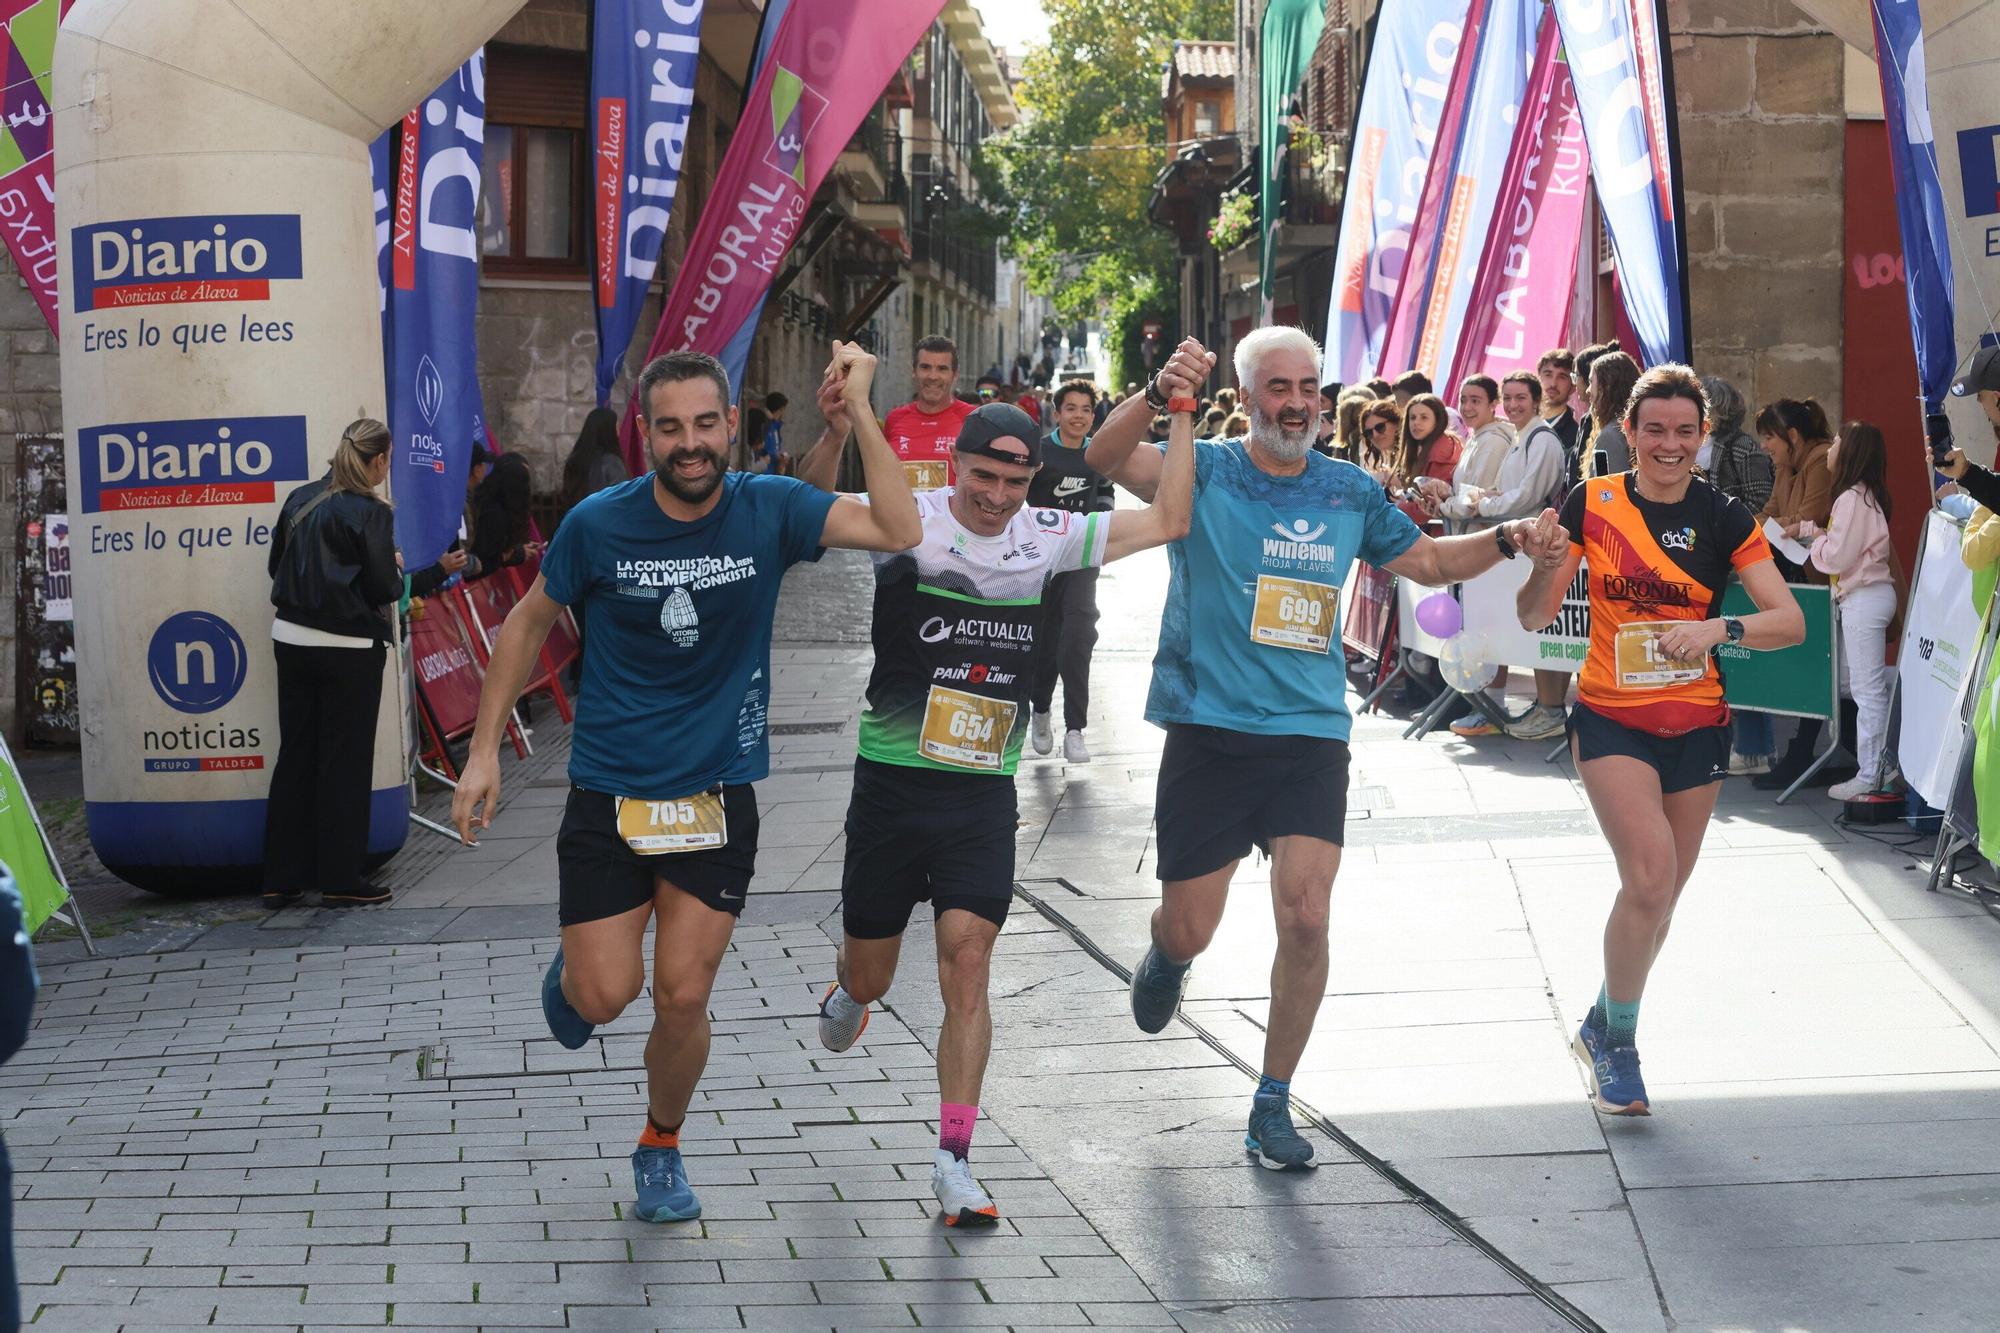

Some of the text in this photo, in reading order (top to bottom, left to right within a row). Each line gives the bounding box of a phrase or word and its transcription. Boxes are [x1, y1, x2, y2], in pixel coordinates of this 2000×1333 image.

[597, 104, 621, 170] Álava
[393, 132, 416, 257] Noticias
[752, 193, 805, 274] kutxa
[92, 223, 268, 281] Diario
[113, 280, 239, 305] Noticias de Álava
[84, 314, 294, 353] Eres lo que lees
[98, 426, 273, 483] Diario
[916, 469, 930, 484] 14
[1060, 476, 1087, 489] NIKE
[119, 484, 244, 508] Noticias de Álava
[1058, 498, 1084, 508] AIR
[91, 525, 134, 554] Eres
[144, 521, 166, 550] lo
[178, 527, 232, 557] que
[616, 560, 633, 572] LA
[616, 571, 628, 579] DE
[629, 571, 640, 579] LA
[1262, 556, 1335, 573] RIOJA ALAVESA
[692, 565, 757, 591] KONKISTA
[1603, 574, 1690, 600] FORONDA
[1278, 595, 1322, 626] 699
[672, 628, 699, 637] VITORIA
[672, 635, 700, 643] GASTEIZ
[955, 619, 1034, 642] ACTUALIZA
[954, 637, 985, 647] software
[990, 640, 1019, 650] websites
[1540, 641, 1591, 661] green capit
[1718, 644, 1751, 660] Gasteizko
[175, 640, 216, 685] n
[933, 667, 970, 681] PAIN
[984, 672, 1017, 685] LIMIT
[143, 722, 261, 750] noticias
[949, 710, 996, 743] 654
[153, 760, 255, 770] GRUPO TALDEA
[645, 801, 696, 826] 705
